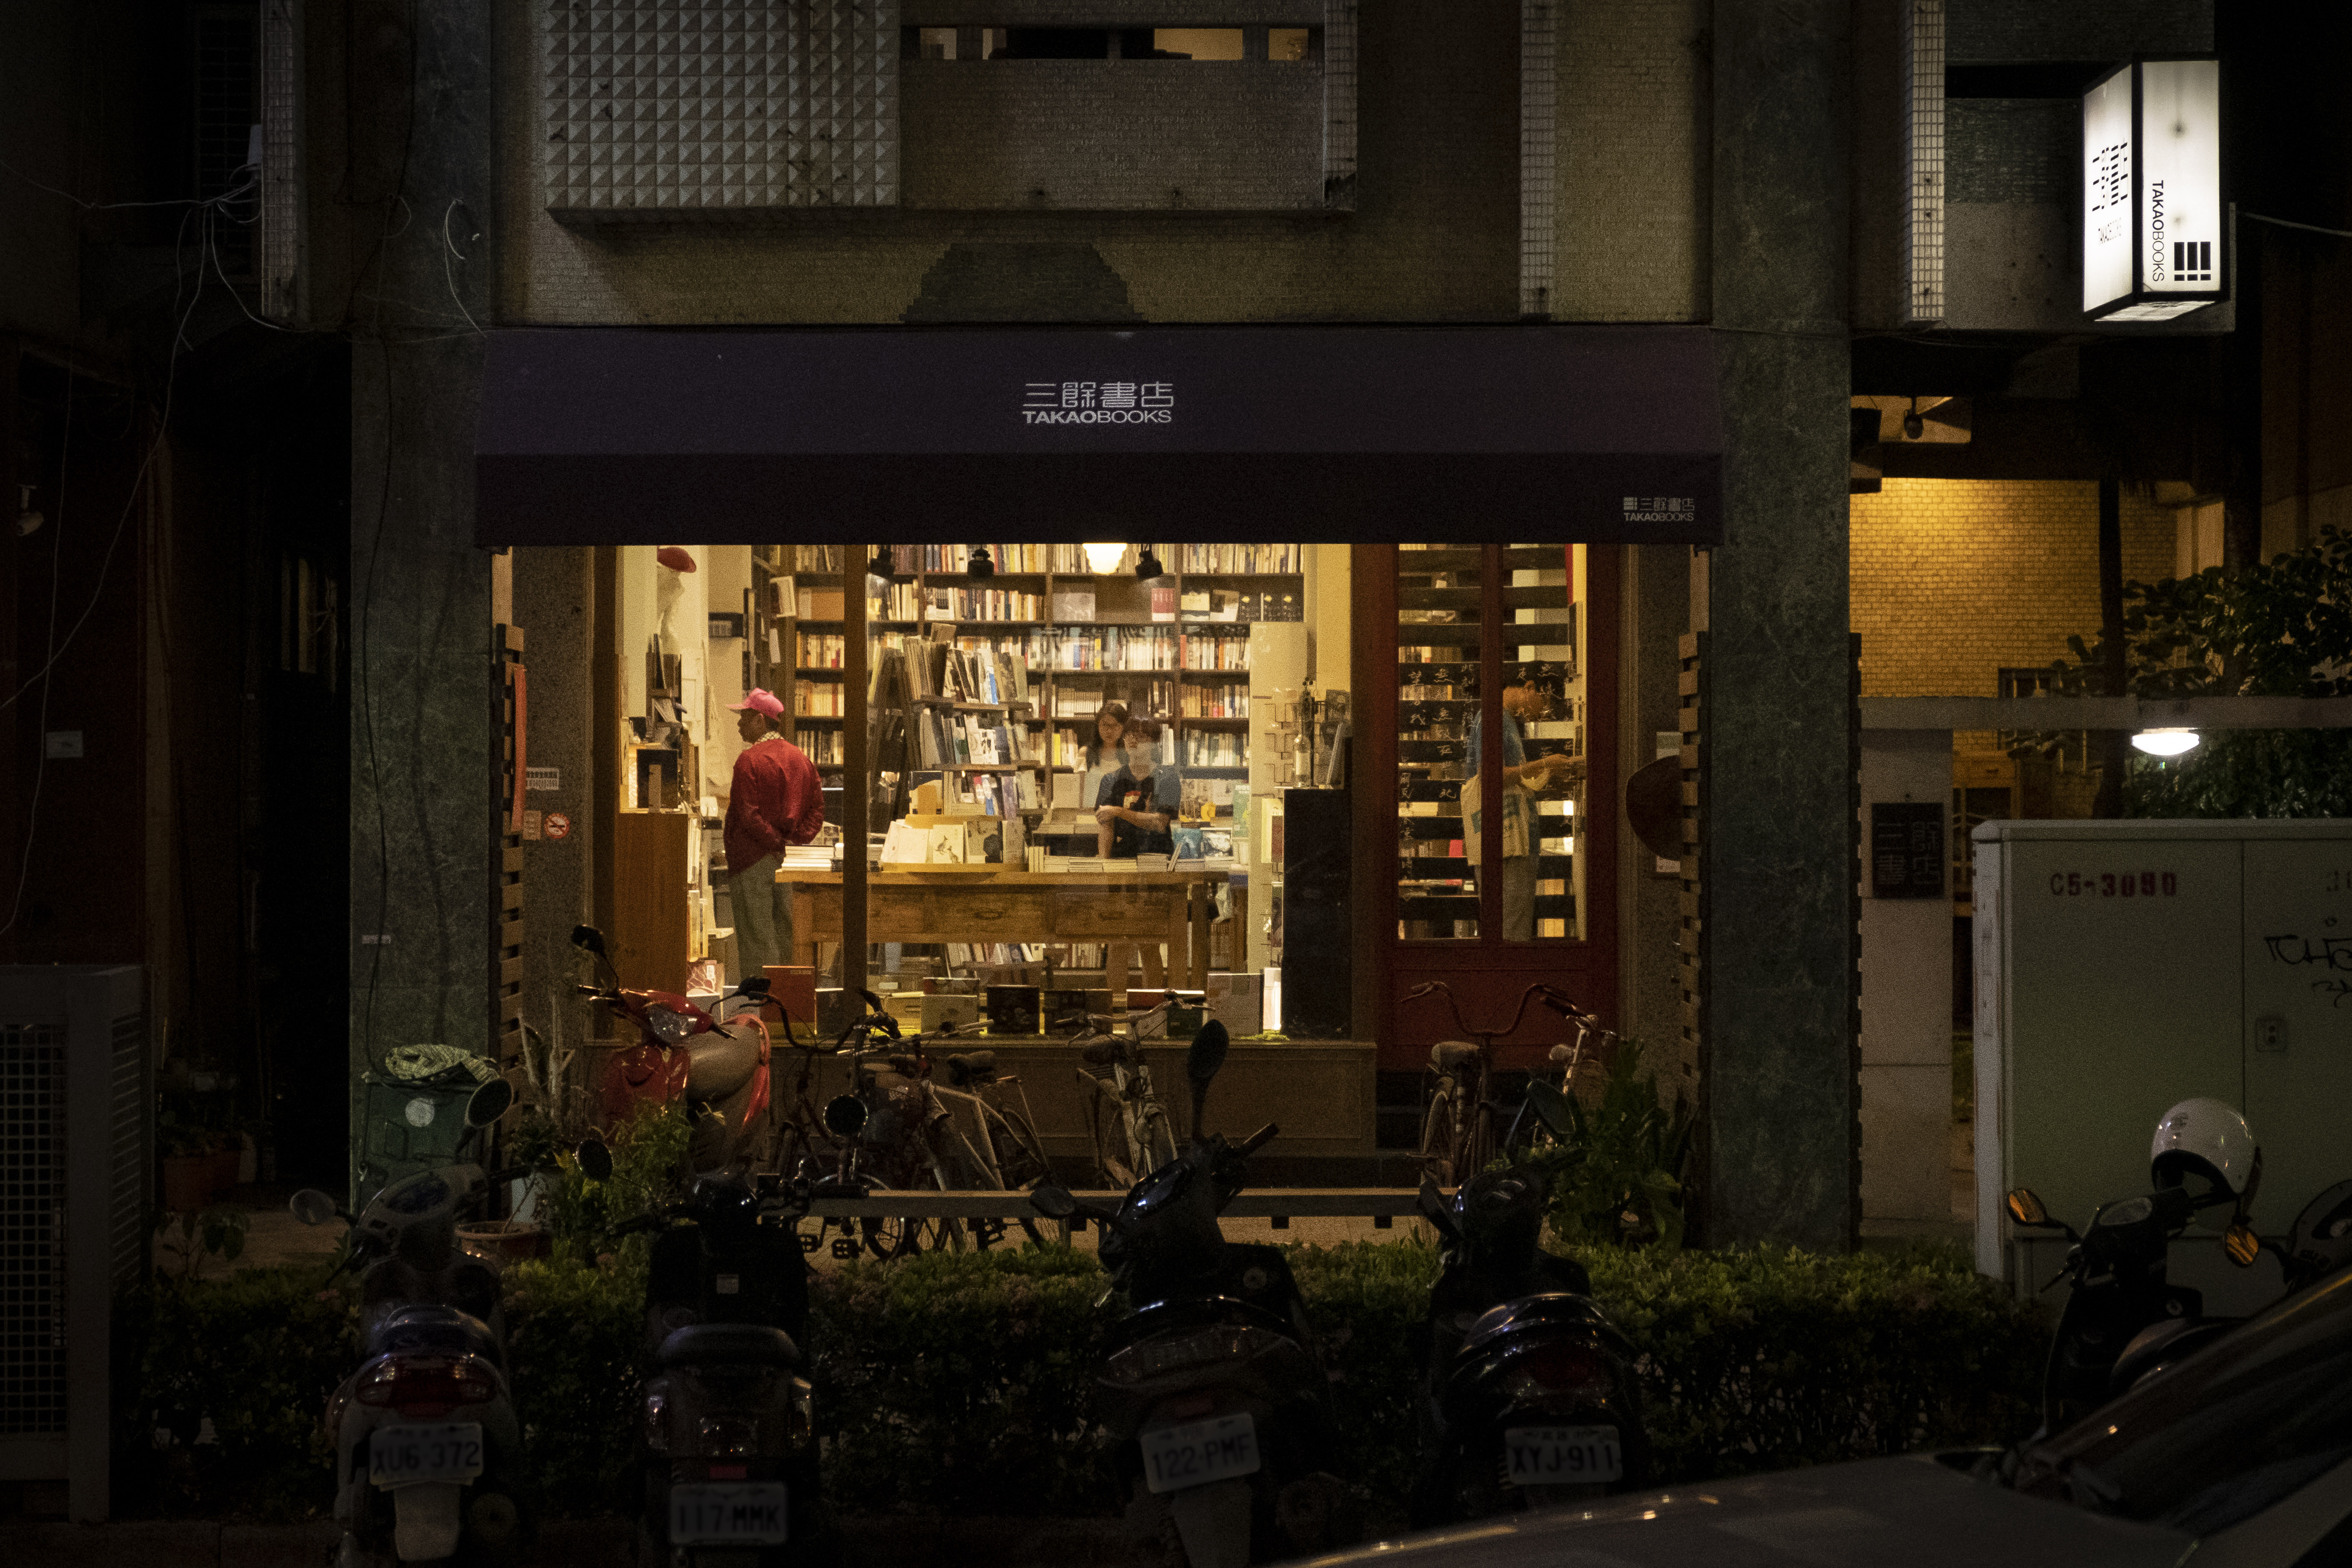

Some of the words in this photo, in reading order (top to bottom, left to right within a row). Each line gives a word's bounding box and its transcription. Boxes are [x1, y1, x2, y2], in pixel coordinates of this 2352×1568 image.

[2151, 179, 2165, 282] TAKAOBOOKS
[1022, 381, 1174, 408] 三餘書店
[1022, 410, 1173, 424] TAKAOBOOKS
[1623, 513, 1694, 522] TAKAOBOOKS
